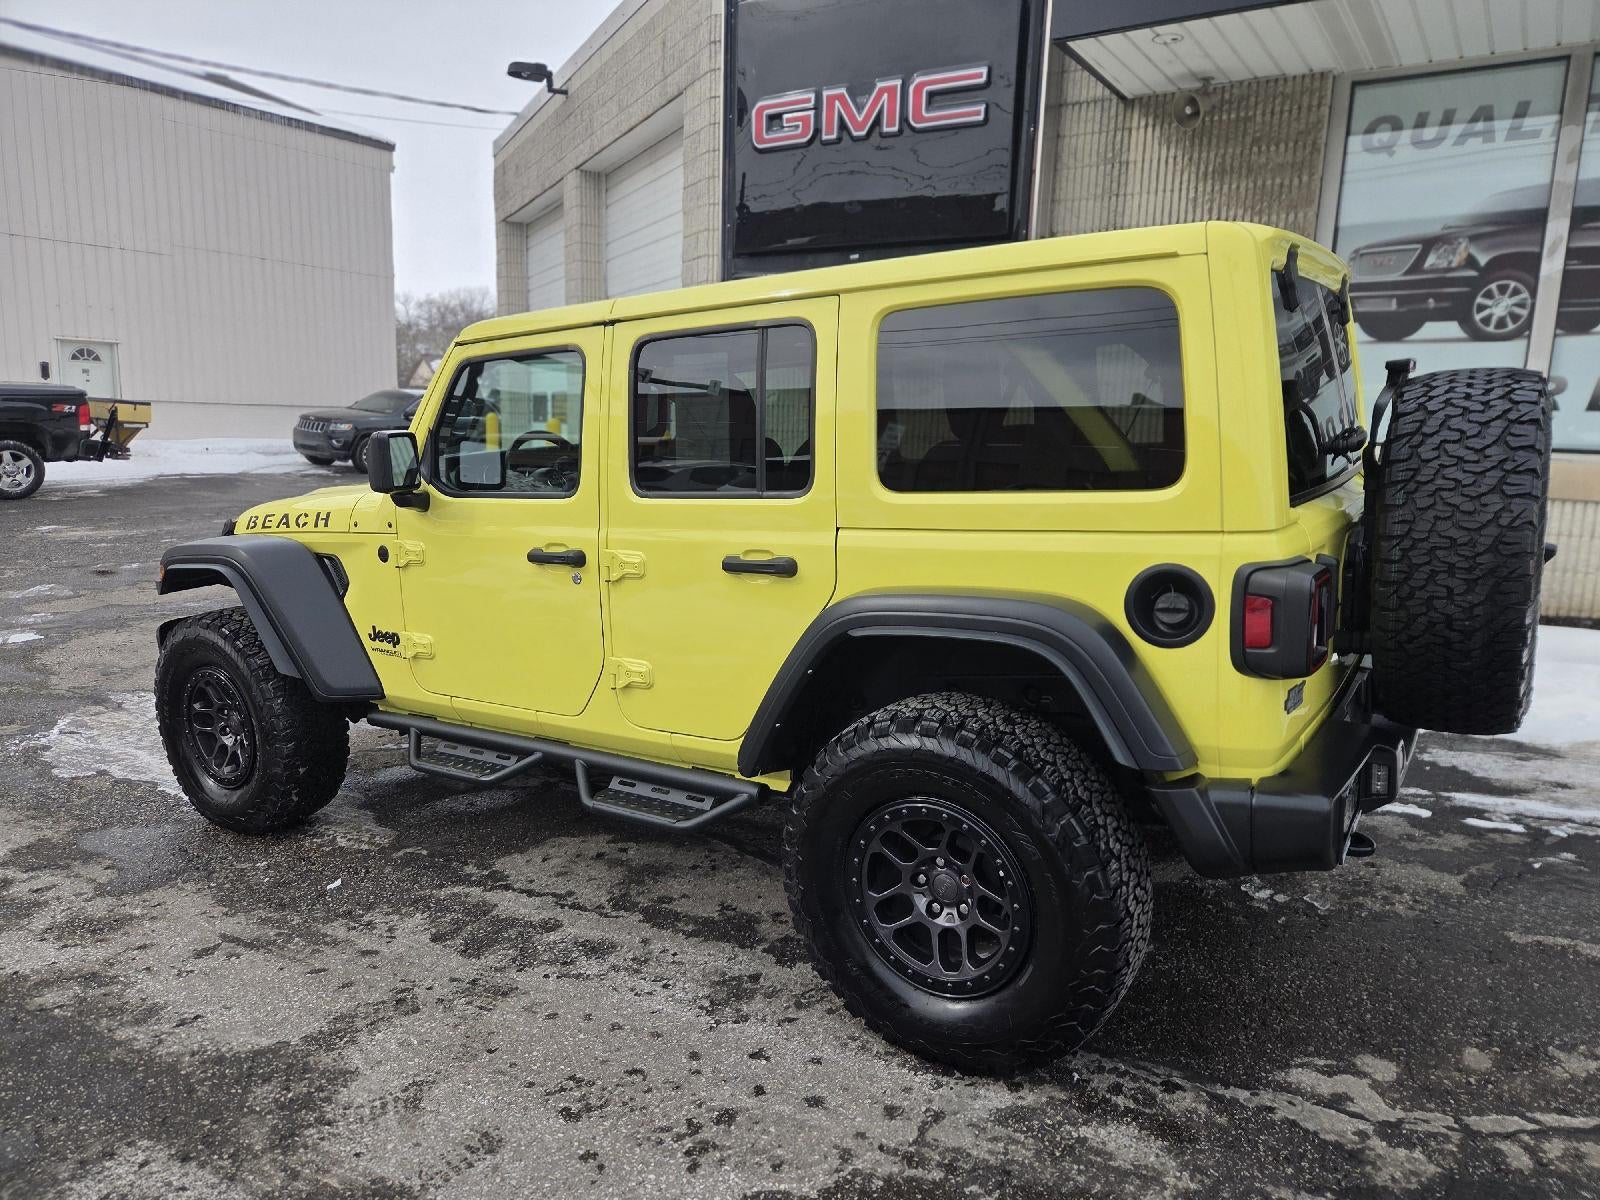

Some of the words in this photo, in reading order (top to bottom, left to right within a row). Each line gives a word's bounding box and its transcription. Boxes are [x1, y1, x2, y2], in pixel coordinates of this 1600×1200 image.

[752, 64, 989, 150] GMC
[246, 511, 331, 530] BEACH
[368, 625, 400, 648] Jeep
